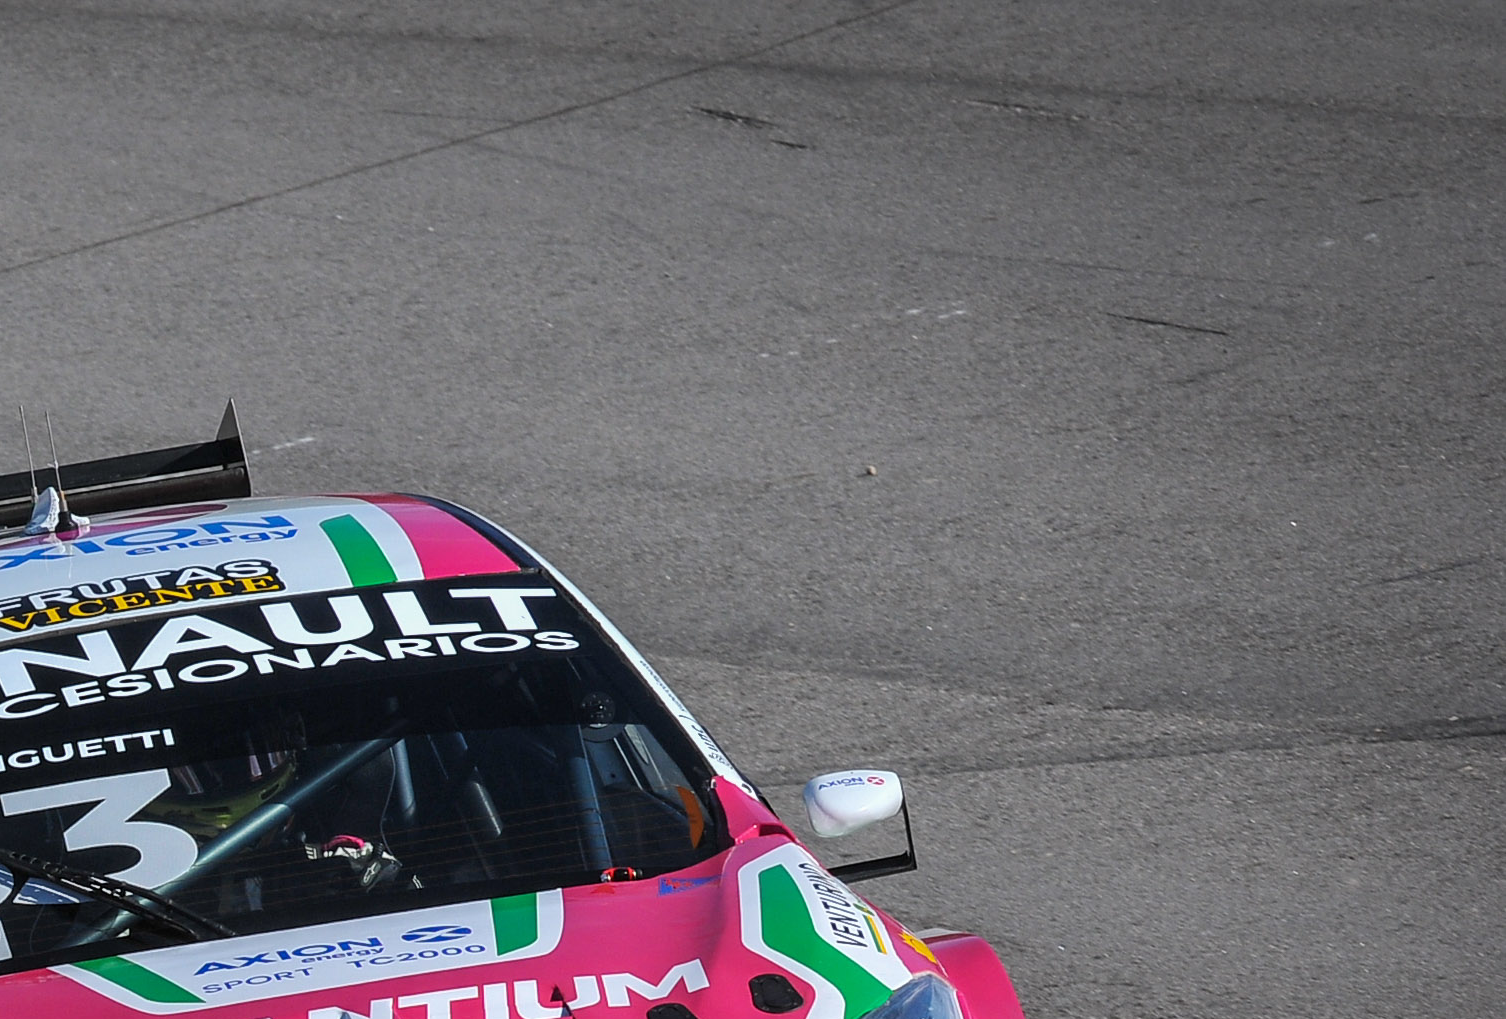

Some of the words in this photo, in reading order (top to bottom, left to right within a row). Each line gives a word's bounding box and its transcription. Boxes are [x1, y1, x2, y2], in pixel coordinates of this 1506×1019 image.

[125, 527, 298, 556] energy
[818, 777, 864, 790] AXION
[194, 936, 383, 976] AXION
[203, 966, 315, 995] SPORT
[345, 942, 486, 973] TC2000
[300, 944, 386, 965] energy
